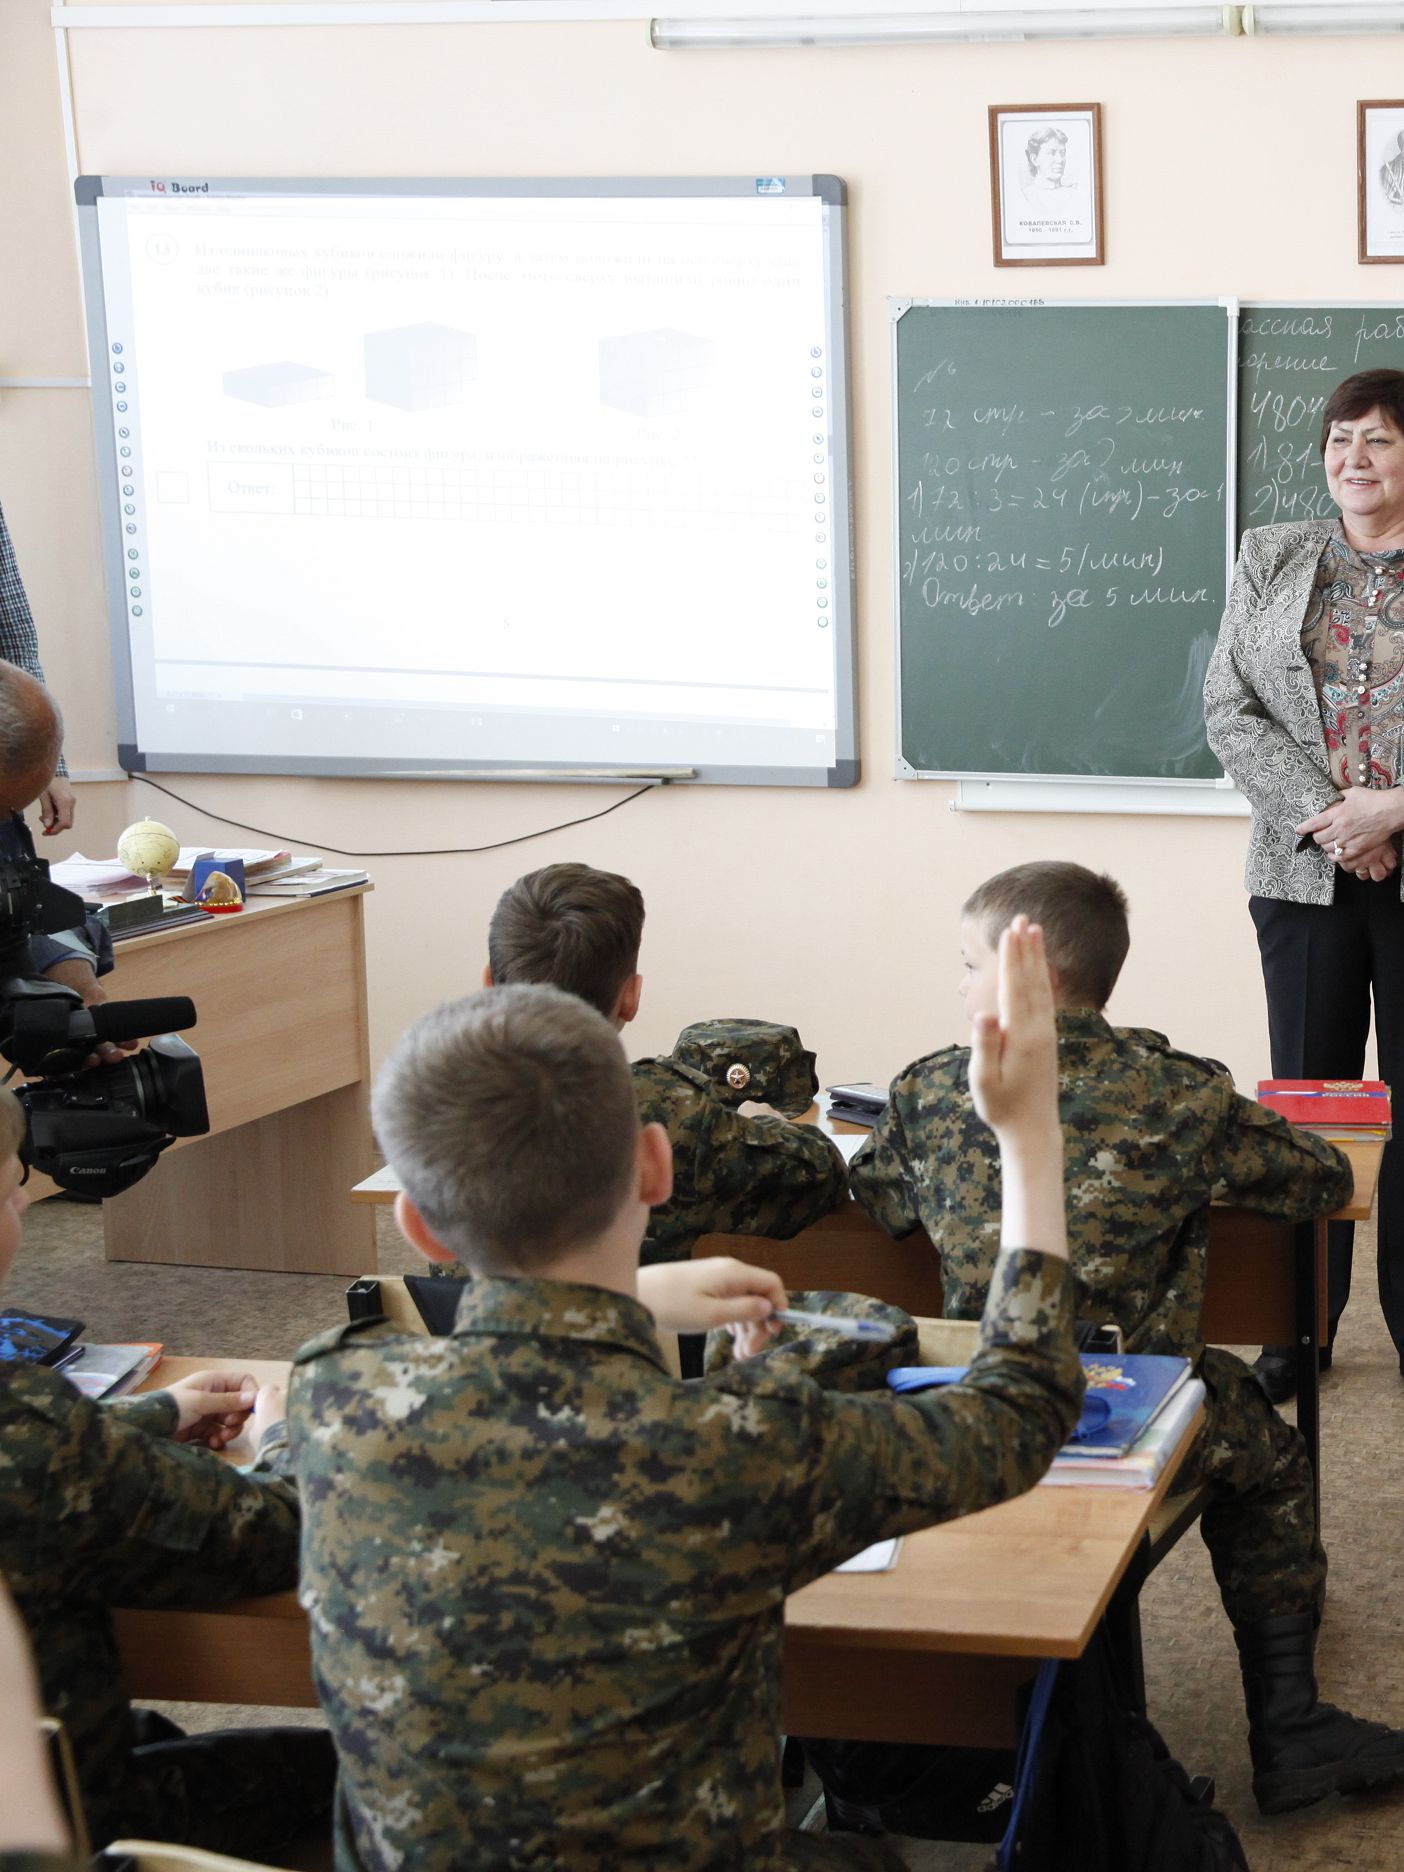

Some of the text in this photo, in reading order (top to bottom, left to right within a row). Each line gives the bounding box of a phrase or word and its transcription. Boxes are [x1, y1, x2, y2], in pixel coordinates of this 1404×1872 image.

[171, 182, 209, 193] Board
[1240, 315, 1334, 339] ассная
[1239, 353, 1338, 385] орение
[70, 1166, 107, 1175] Canon
